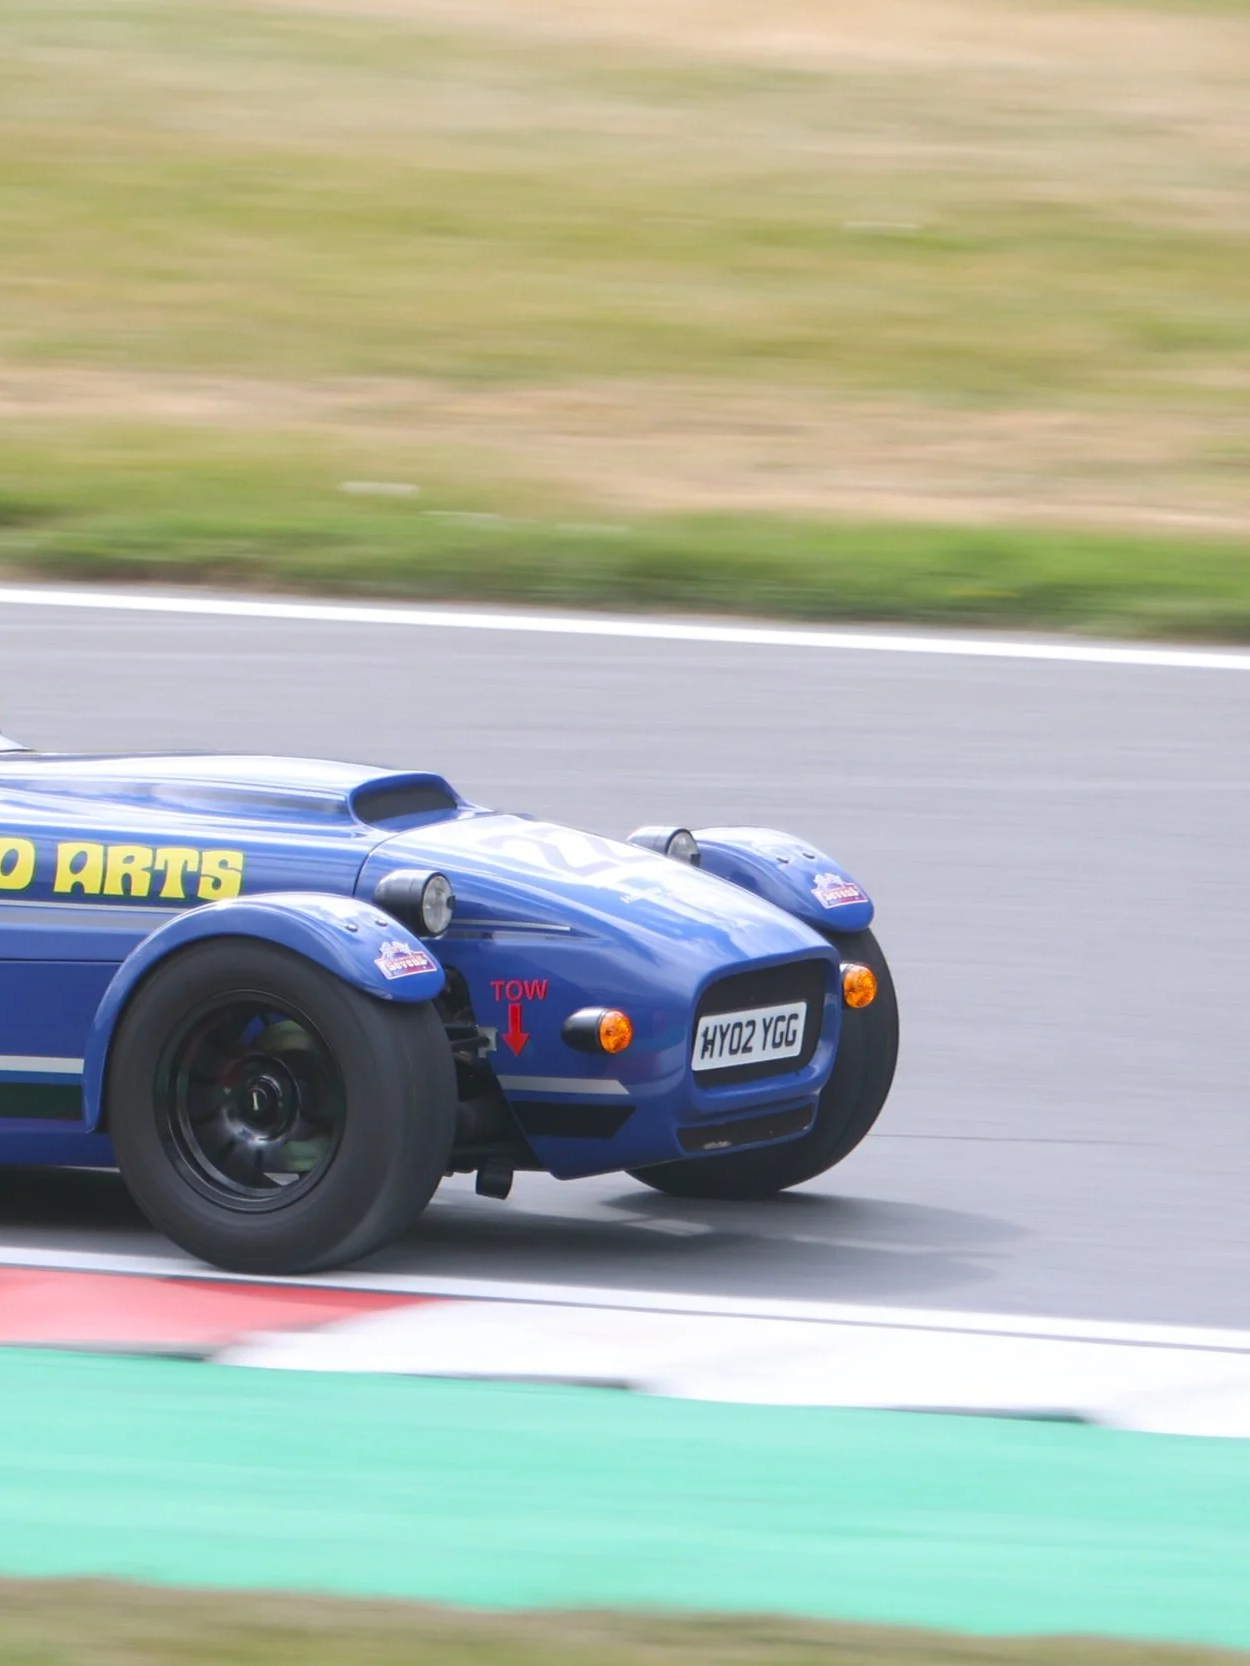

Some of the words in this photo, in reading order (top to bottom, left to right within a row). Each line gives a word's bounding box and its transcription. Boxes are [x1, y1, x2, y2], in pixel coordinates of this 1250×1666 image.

[53, 842, 244, 900] ARTS
[490, 979, 548, 1001] TOW
[700, 1019, 756, 1060] HY02
[762, 1013, 799, 1051] YGG
